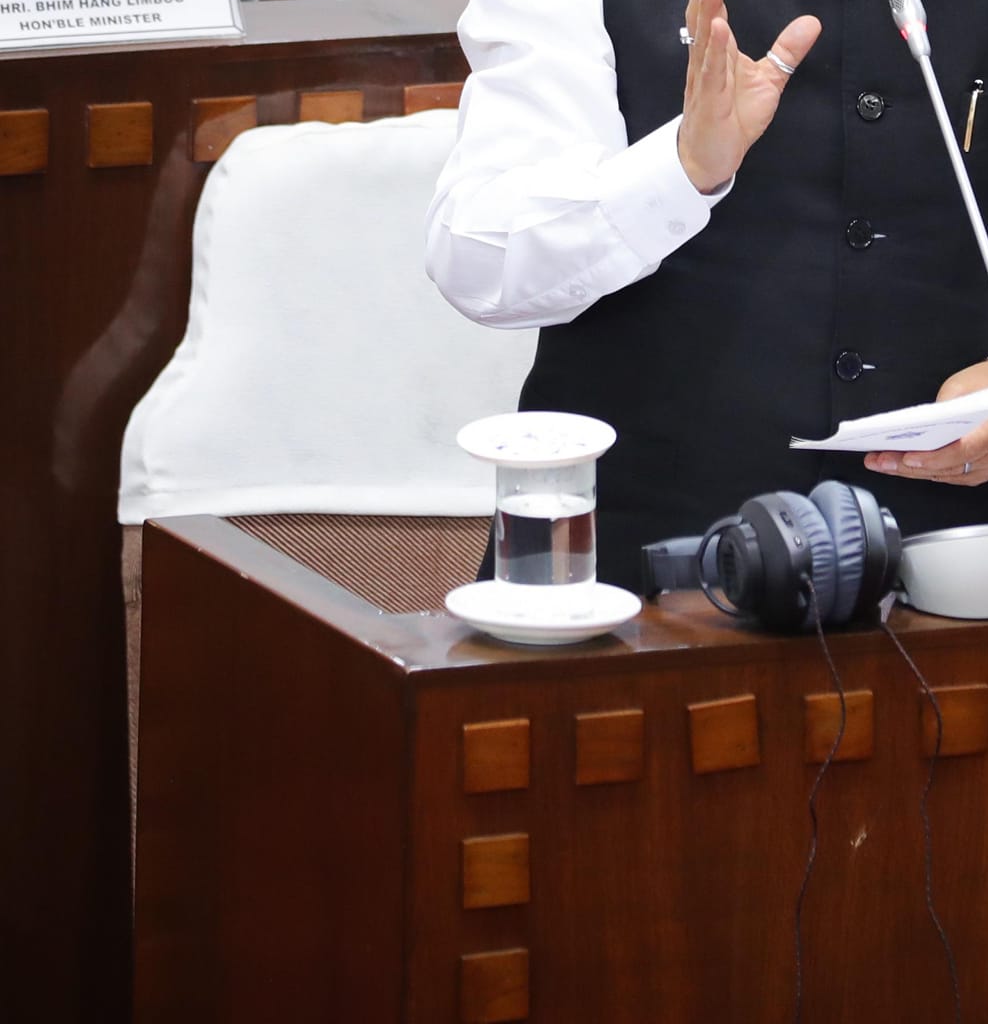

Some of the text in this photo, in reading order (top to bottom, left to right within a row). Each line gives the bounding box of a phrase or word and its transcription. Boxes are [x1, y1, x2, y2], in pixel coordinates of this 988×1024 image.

[0, 2, 31, 14] HRI.
[36, 0, 74, 12] BHIM
[19, 12, 163, 31] HON'BLE MINISTER
